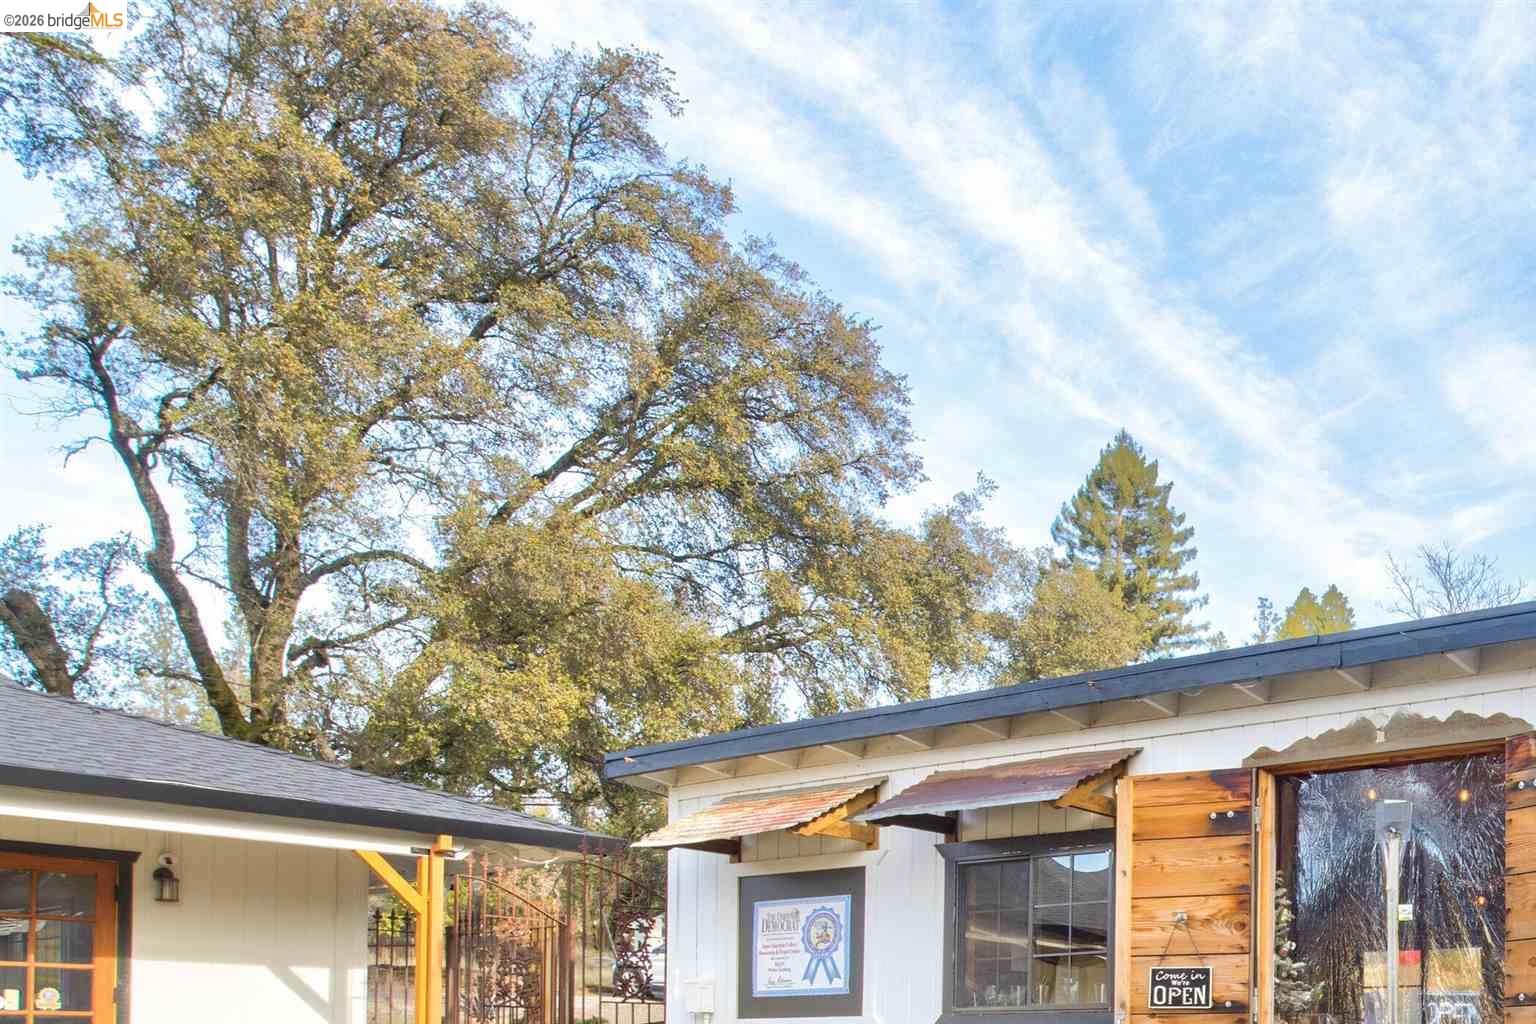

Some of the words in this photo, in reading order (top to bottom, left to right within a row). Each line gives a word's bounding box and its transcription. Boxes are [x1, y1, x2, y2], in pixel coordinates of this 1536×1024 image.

[1155, 970, 1188, 981] Come
[1190, 970, 1206, 980] in
[1153, 985, 1206, 1005] OPEN
